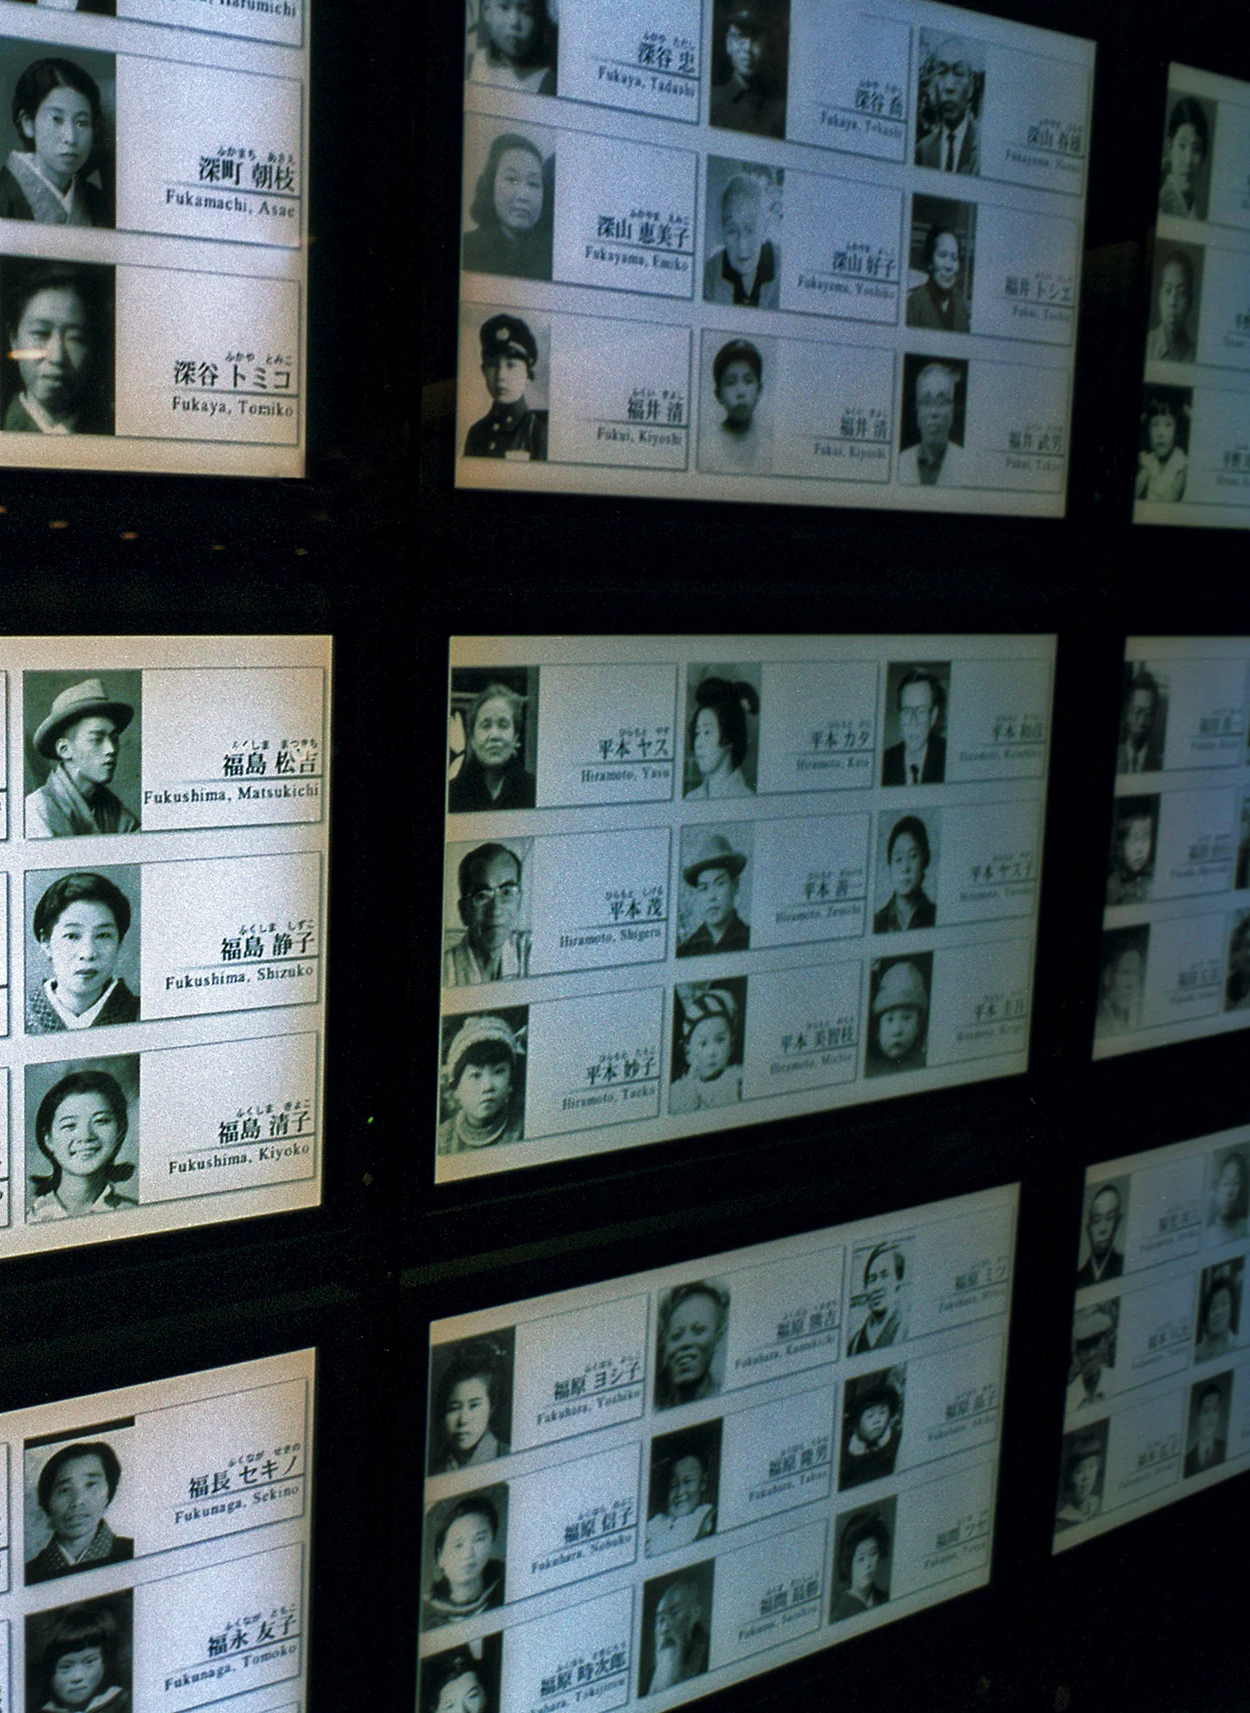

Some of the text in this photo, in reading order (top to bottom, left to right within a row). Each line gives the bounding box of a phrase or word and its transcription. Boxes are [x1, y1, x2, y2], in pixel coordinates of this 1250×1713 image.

[199, 155, 295, 192] 深町 朝枝
[166, 188, 295, 217] Fukamachi, Asae
[174, 360, 290, 390] 深谷 トミコ
[173, 396, 293, 417] Fukaya, Tomiko
[223, 750, 318, 777] 福島 松吉
[144, 784, 319, 804] Fukushima, Matsukichi
[221, 931, 315, 961] 福島 静子
[166, 964, 314, 990] Fukushima, Shizuko
[218, 1110, 311, 1144] 福島 清子
[169, 1143, 310, 1174] Fukushima, Kiyoko
[189, 1456, 297, 1500] 福長 セキノ
[175, 1486, 299, 1524] Fukunaga, Sekino
[208, 1614, 297, 1658] 福永 友子
[164, 1644, 297, 1692] Fukunaga, Tomoko
